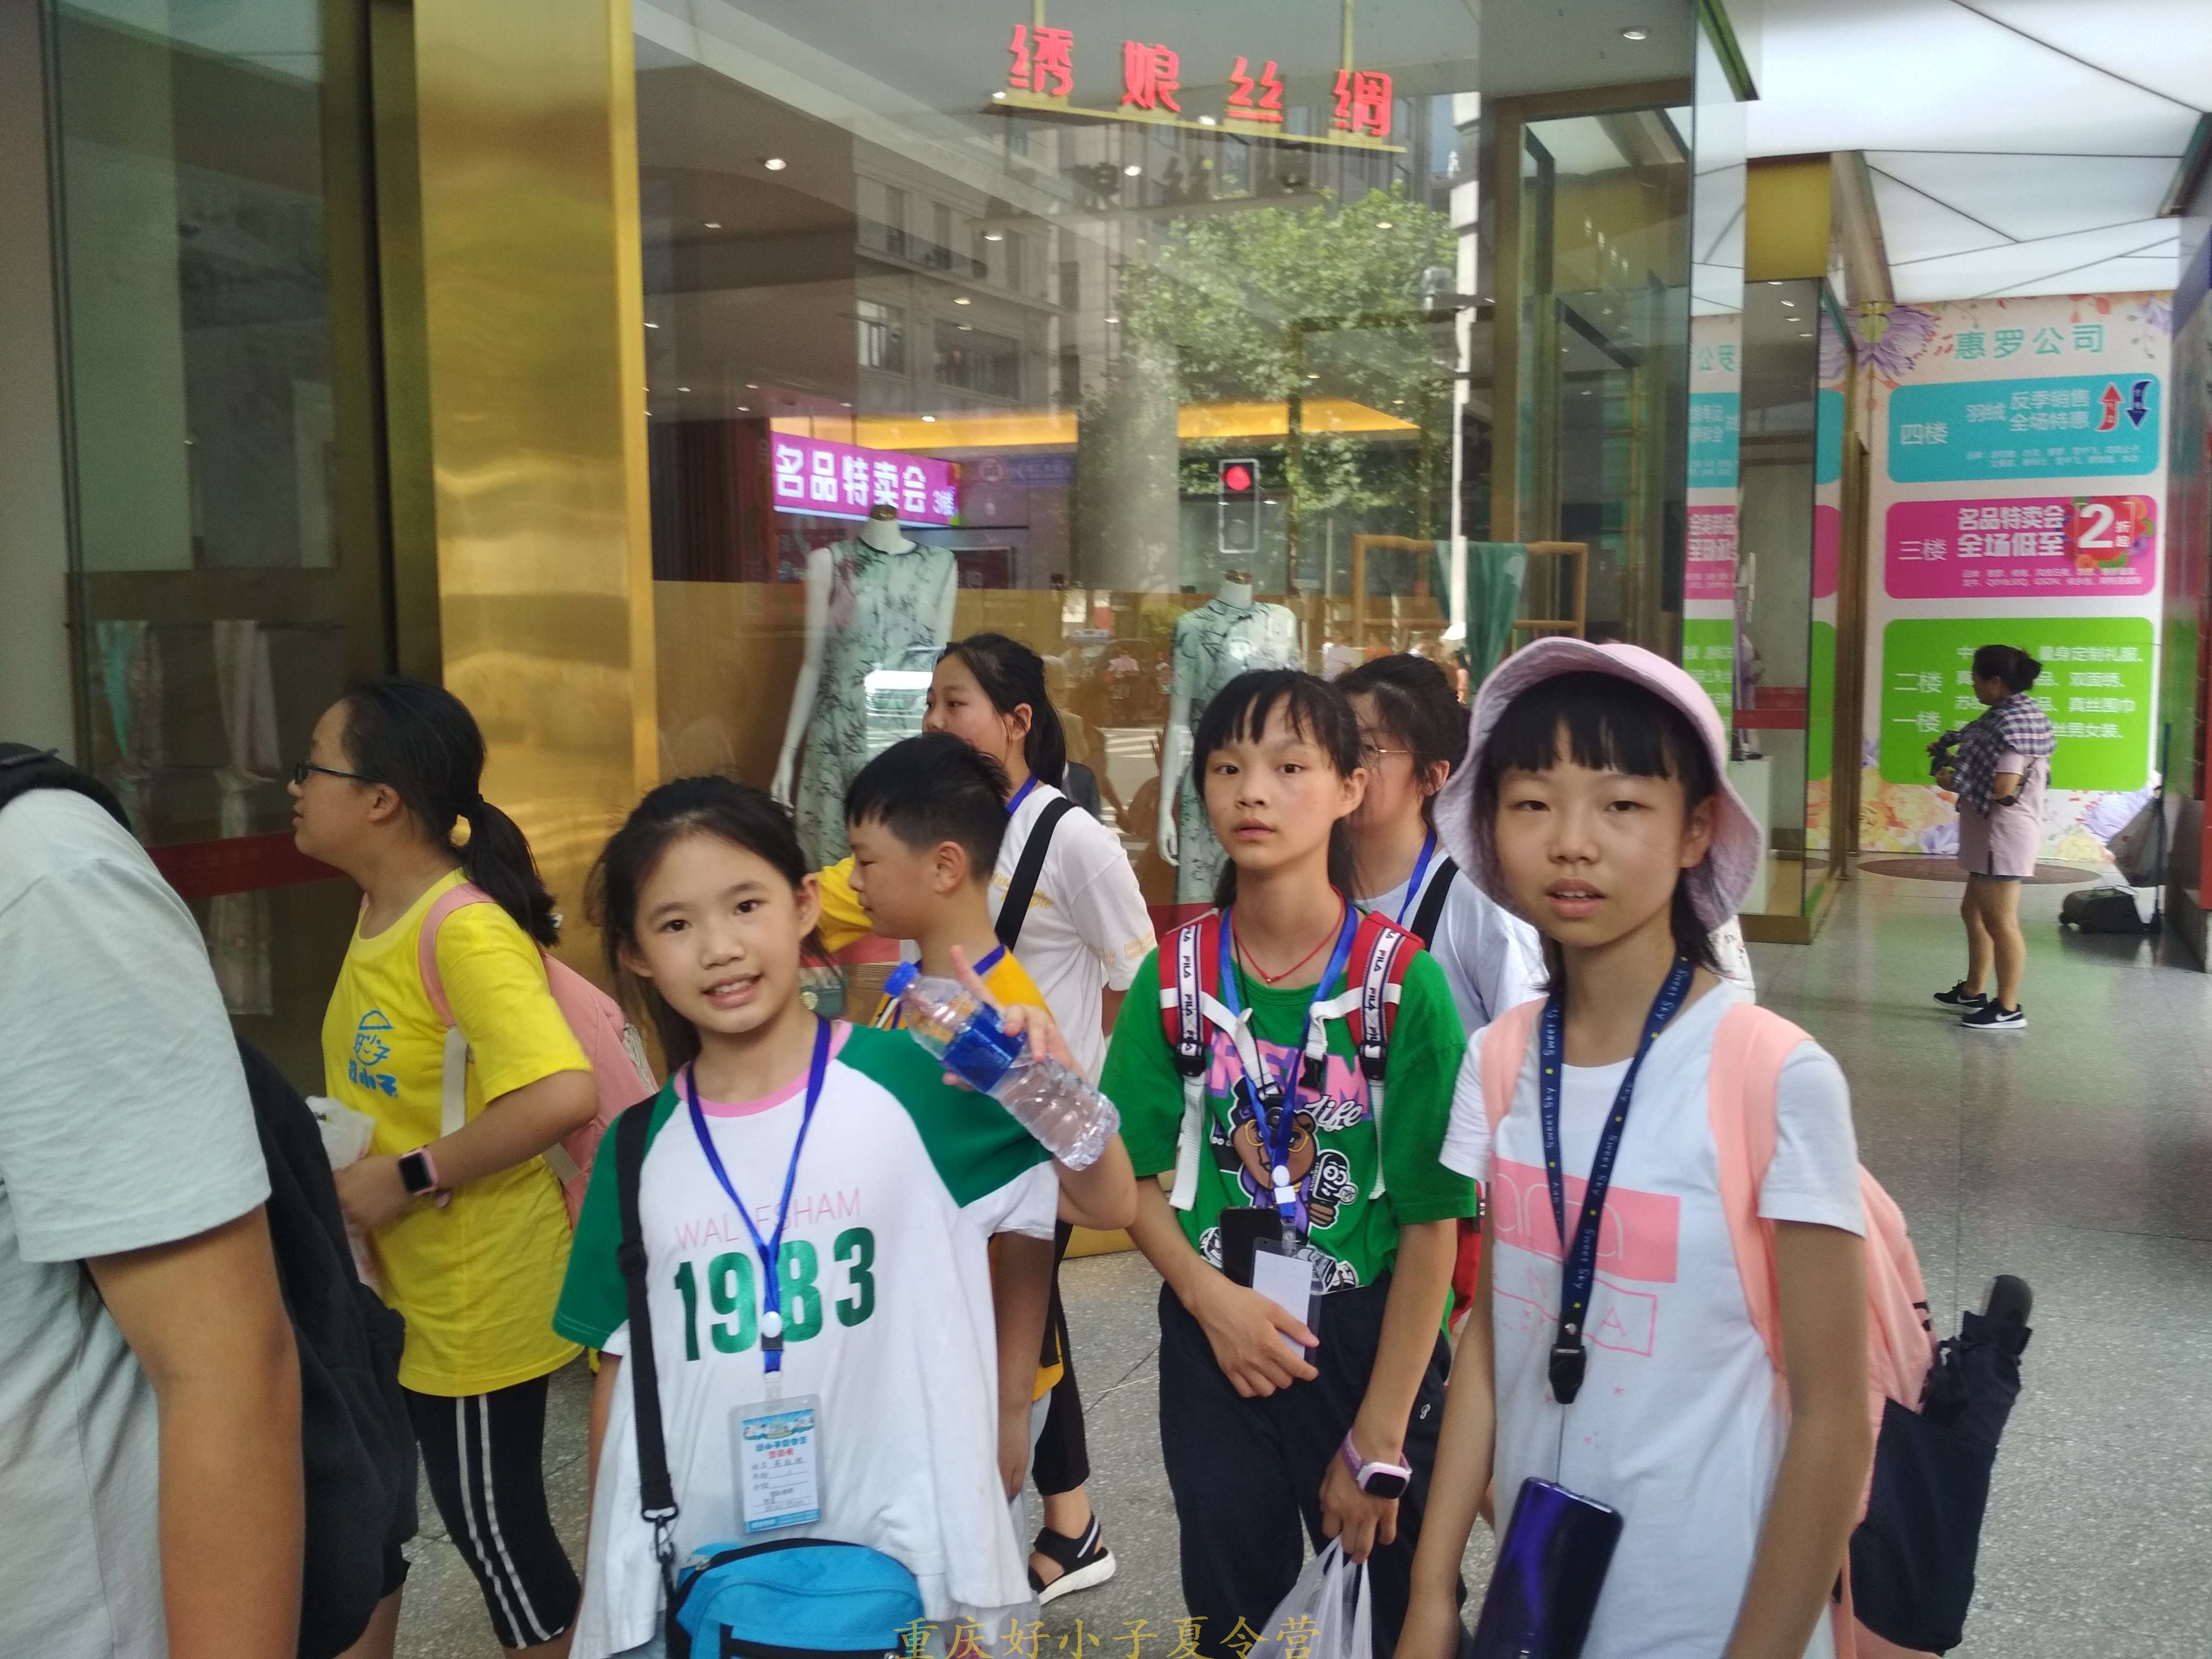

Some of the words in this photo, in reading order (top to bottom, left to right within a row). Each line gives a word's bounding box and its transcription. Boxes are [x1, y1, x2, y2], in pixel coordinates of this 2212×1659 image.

[1010, 24, 1393, 137] 绣娘丝绸
[1954, 324, 2104, 359] 惠罗公司
[1900, 422, 1948, 446] 四楼
[775, 445, 926, 514] 名品特卖会
[1958, 505, 2065, 531] 名品特卖会
[2078, 504, 2115, 548] 2
[1898, 539, 1947, 561] 三楼
[1957, 532, 2064, 557] 全场低至
[1893, 671, 1942, 693] 二楼
[1892, 710, 1941, 733] 一楼
[1183, 955, 1192, 979] FILA
[1374, 949, 1387, 972] FILA
[1184, 993, 1193, 1017] FILA
[1368, 987, 1377, 1011] FILA
[1304, 1095, 1364, 1132] Life
[674, 1227, 875, 1362] 1983
